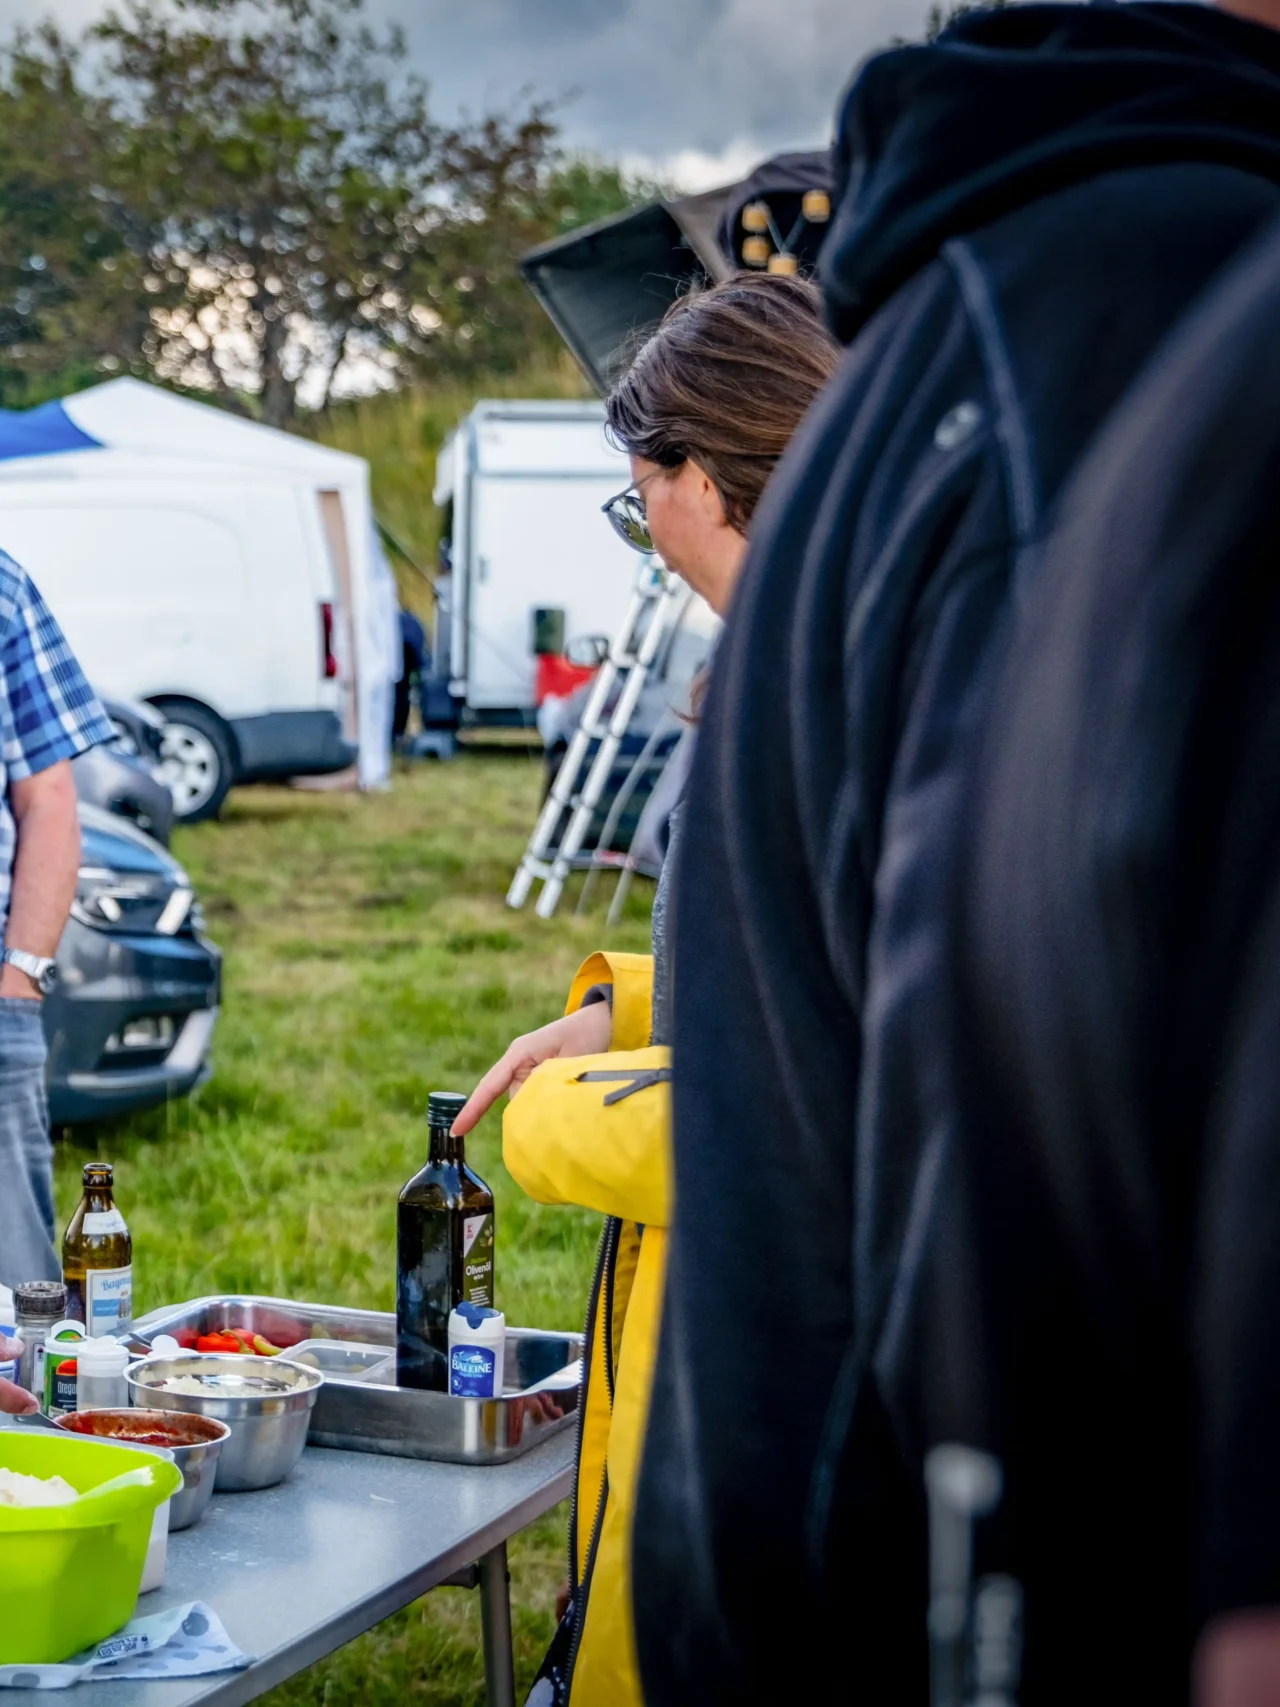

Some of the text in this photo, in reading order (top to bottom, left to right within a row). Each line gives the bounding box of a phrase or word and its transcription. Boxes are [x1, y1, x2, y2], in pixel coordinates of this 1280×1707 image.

[465, 1261, 491, 1276] Olivenöl
[452, 1359, 492, 1373] BALEINE
[57, 1381, 77, 1394] Orega
